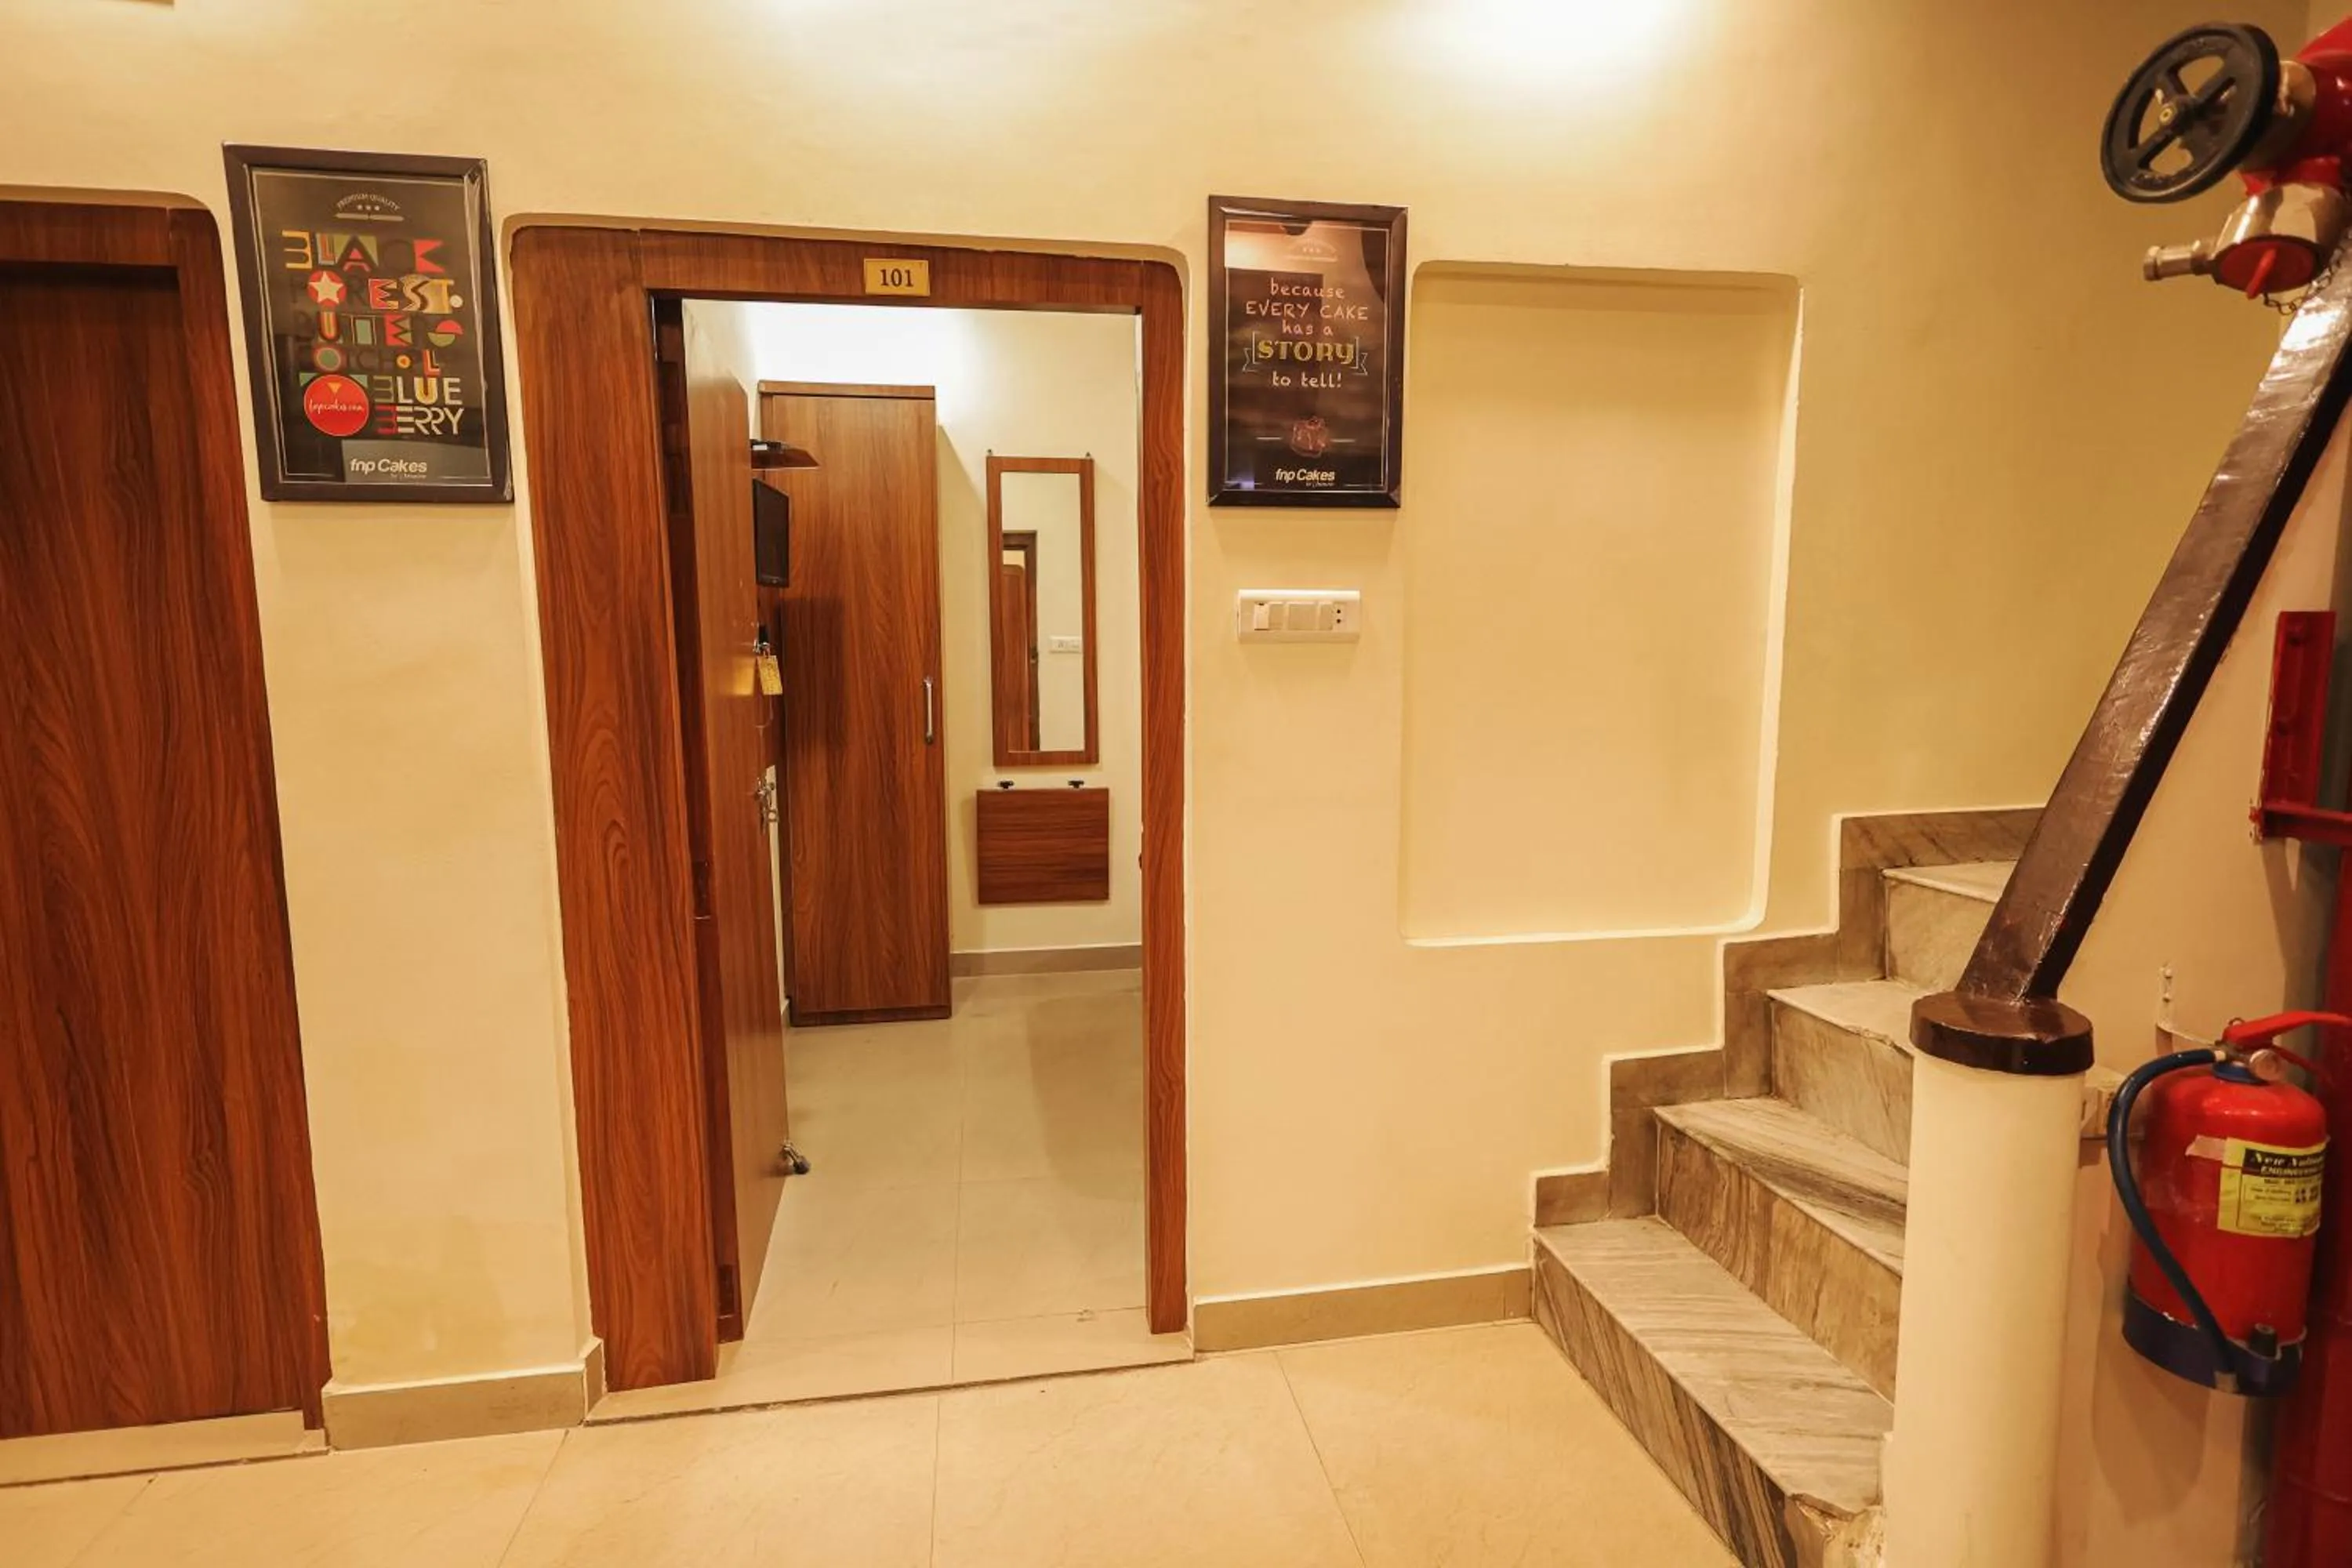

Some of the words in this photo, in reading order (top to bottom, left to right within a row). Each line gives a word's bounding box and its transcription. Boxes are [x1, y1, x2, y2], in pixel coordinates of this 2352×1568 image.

[282, 230, 447, 274] BLACK
[880, 268, 914, 288] 101
[1271, 278, 1345, 299] because
[1246, 299, 1309, 319] EVERY
[1319, 303, 1368, 321] CAKE
[1282, 320, 1313, 336] has
[1323, 325, 1334, 336] a
[1257, 340, 1355, 365] STORY
[373, 375, 463, 406] BLUE
[1272, 372, 1292, 387] to
[1301, 372, 1343, 389] tell!
[375, 405, 465, 436] BERRY
[350, 458, 376, 476] fnp
[378, 459, 428, 474] Cakes
[1276, 468, 1295, 484] fnp
[1297, 469, 1335, 481] Cakes
